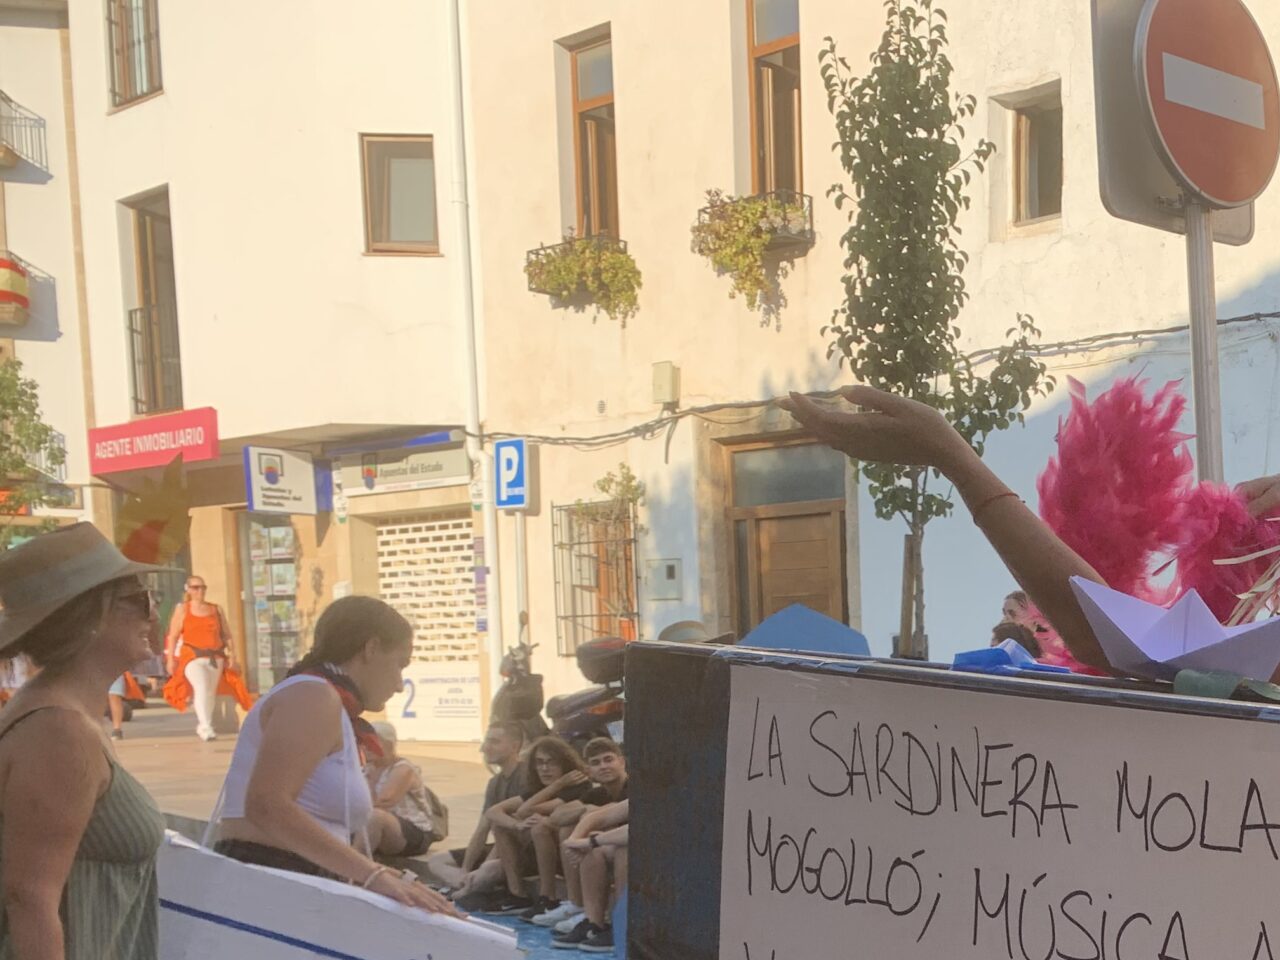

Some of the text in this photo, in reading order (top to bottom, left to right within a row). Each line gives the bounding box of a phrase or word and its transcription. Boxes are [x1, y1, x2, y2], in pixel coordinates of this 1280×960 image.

[95, 426, 204, 459] AGENTE INMOBILIARIO
[500, 446, 519, 501] P
[402, 678, 417, 718] 2
[747, 697, 786, 786] LA
